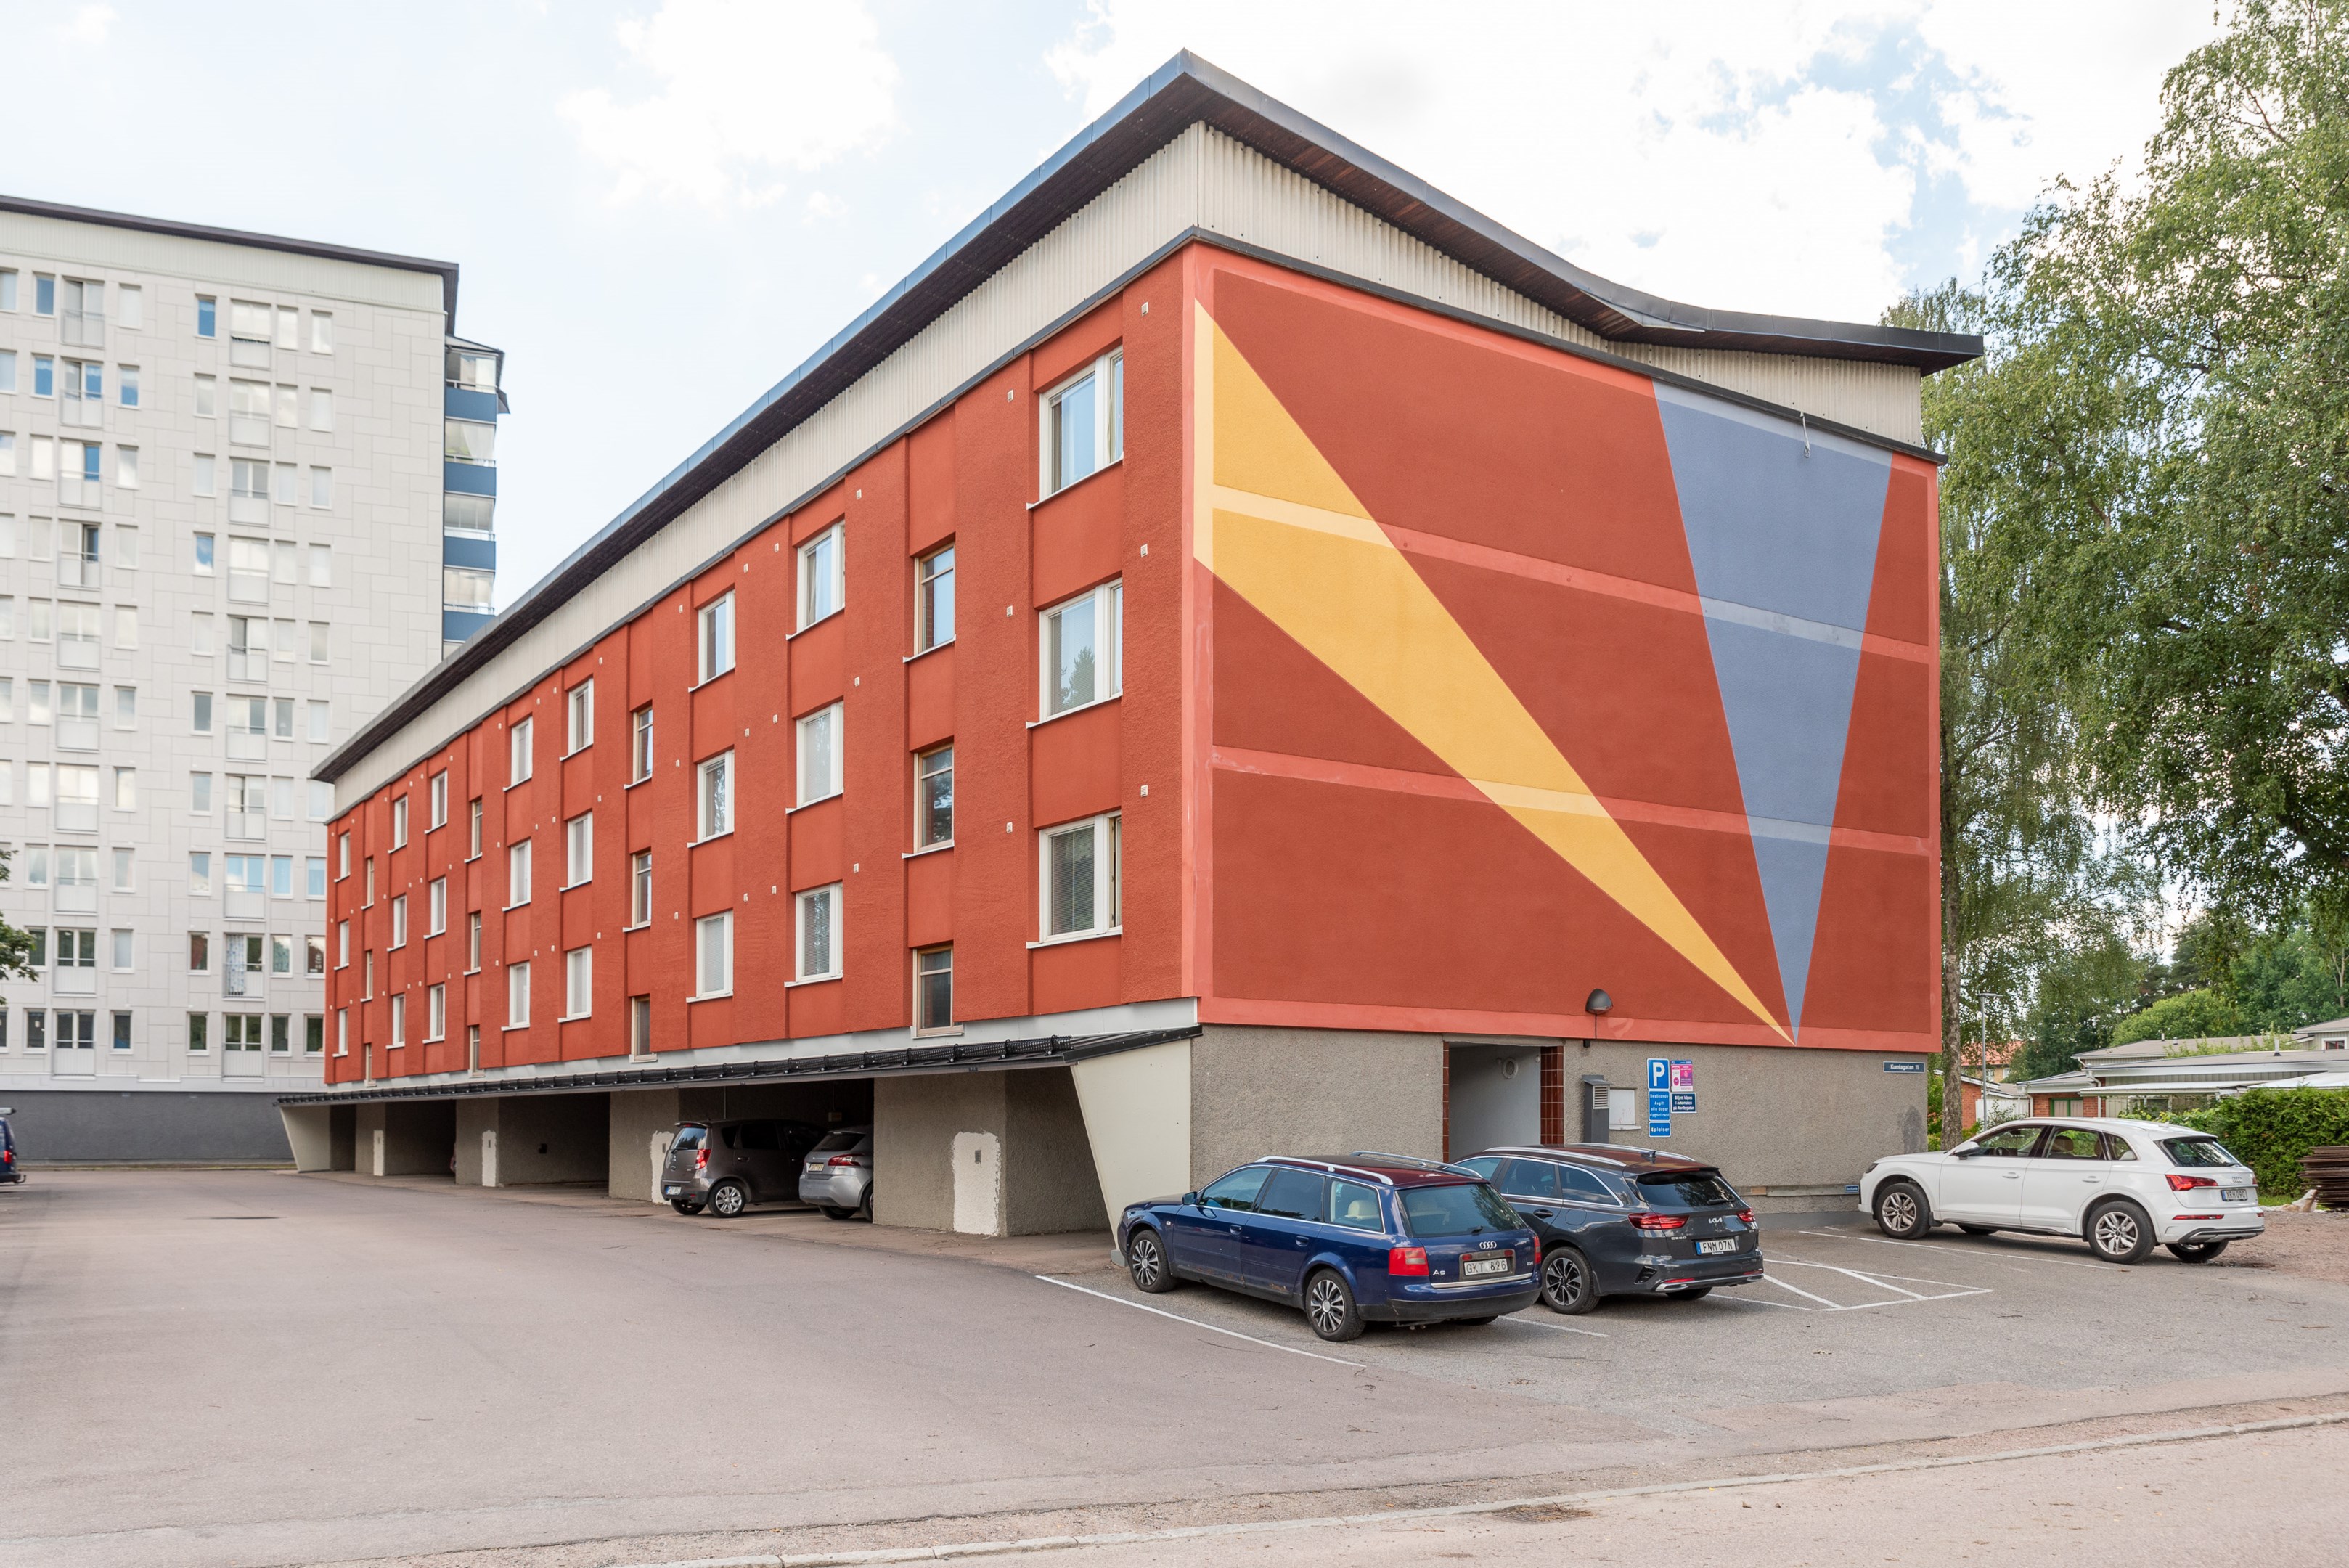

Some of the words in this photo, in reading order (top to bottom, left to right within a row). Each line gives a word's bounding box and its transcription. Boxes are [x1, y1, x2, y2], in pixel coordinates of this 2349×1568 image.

[1653, 1062, 1665, 1087] P
[1702, 1241, 1717, 1252] FNM
[1718, 1240, 1733, 1251] 07N
